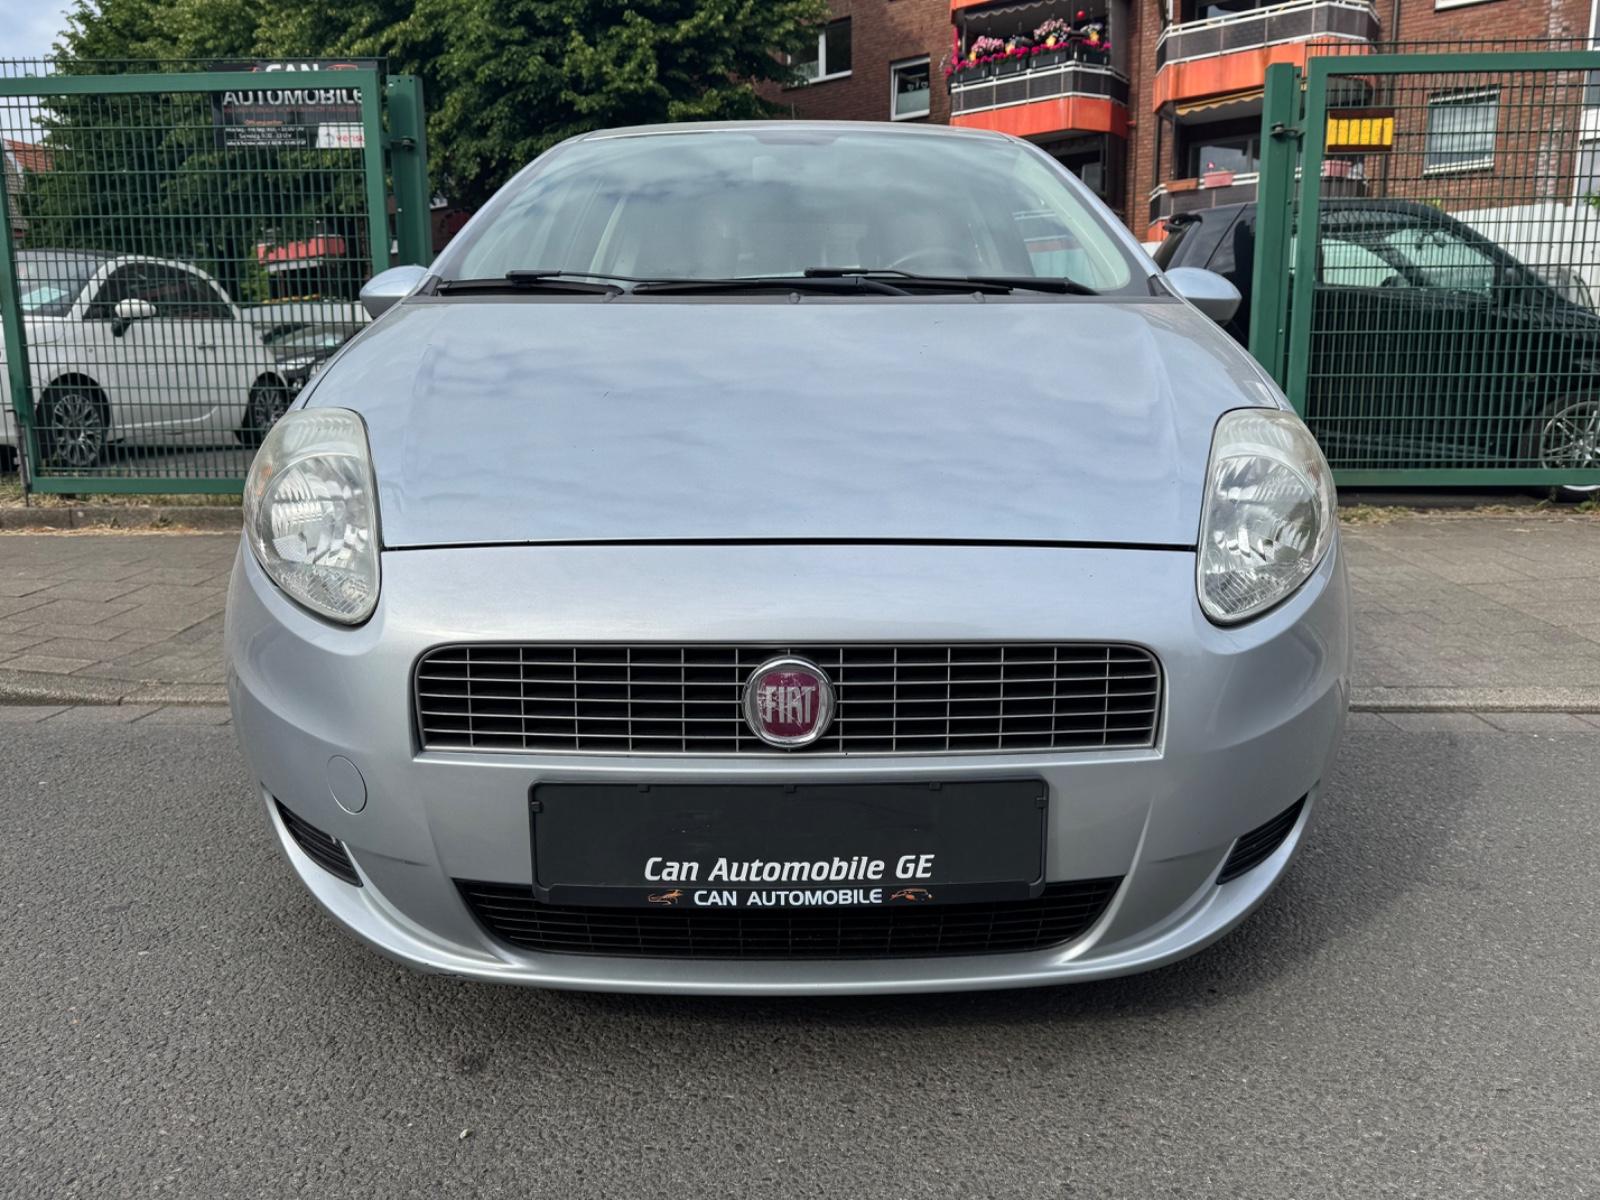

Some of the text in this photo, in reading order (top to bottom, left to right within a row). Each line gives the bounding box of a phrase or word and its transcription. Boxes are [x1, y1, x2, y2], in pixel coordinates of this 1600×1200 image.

[765, 686, 816, 723] FIAT
[644, 854, 935, 881] Can Automobile GE
[693, 888, 883, 906] CAN AUTOMOBILE
